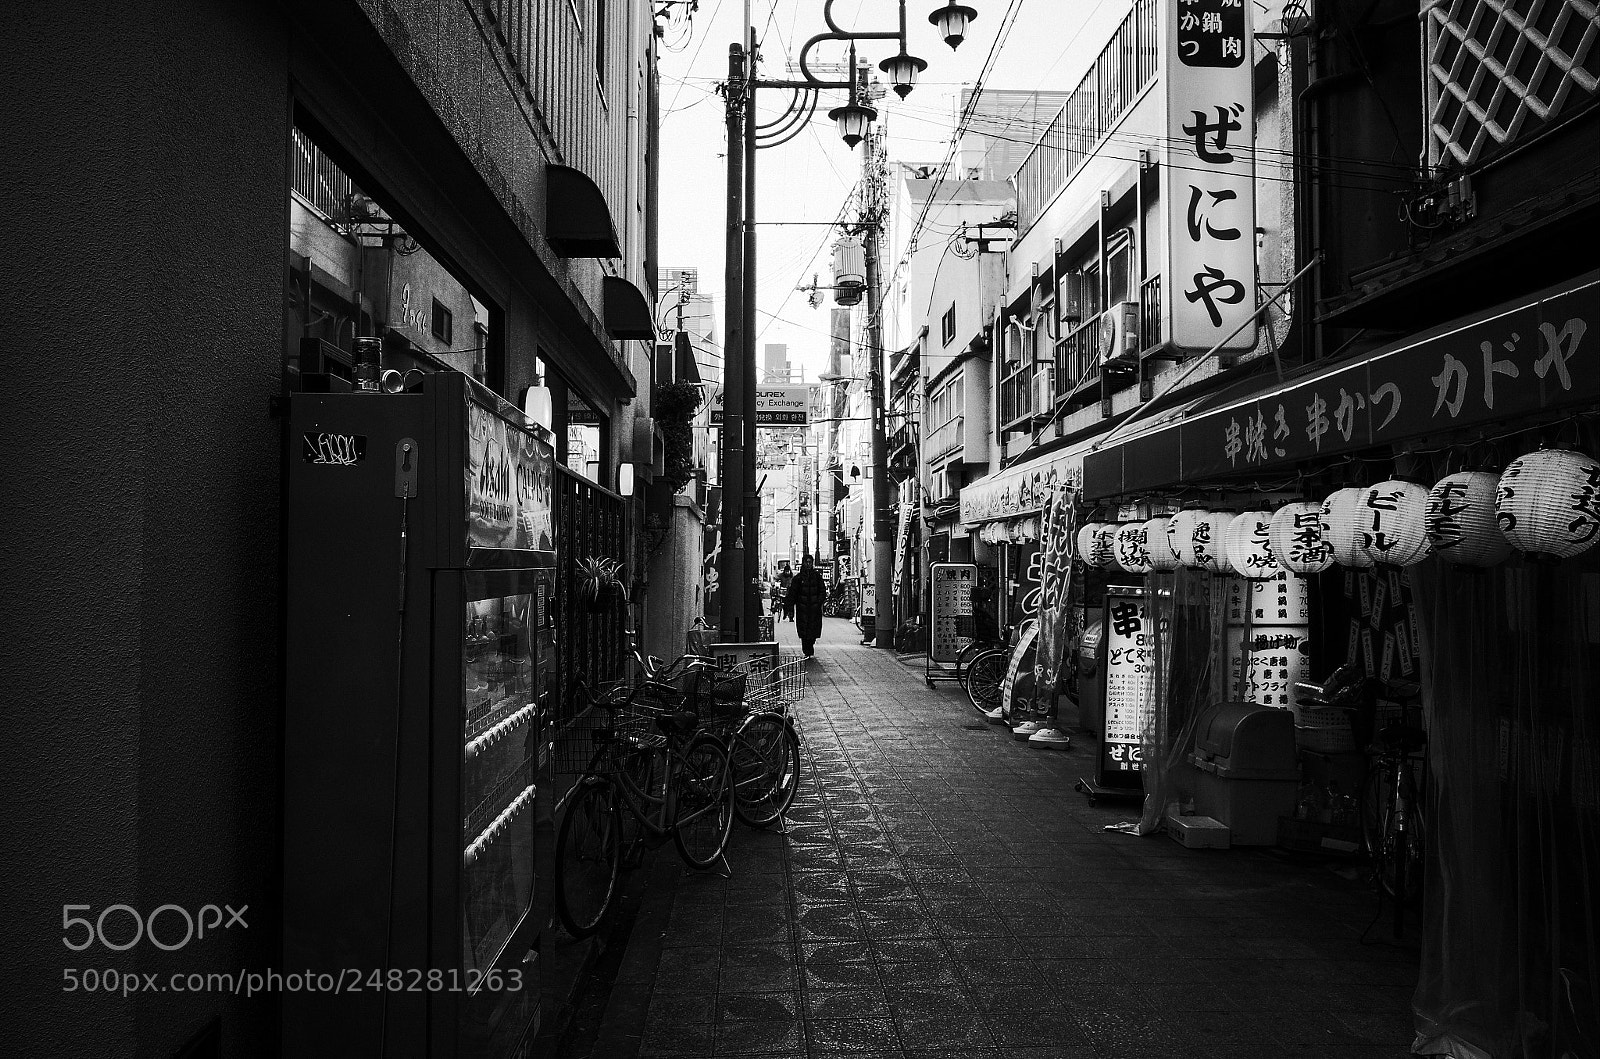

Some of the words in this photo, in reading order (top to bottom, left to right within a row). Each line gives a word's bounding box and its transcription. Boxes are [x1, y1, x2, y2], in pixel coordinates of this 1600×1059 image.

[1182, 102, 1246, 328] ぜにや
[768, 399, 804, 408] Exchange
[1224, 403, 1291, 468] 串焼き
[1305, 381, 1402, 452] 串かつ
[1431, 317, 1588, 418] カドヤ
[480, 439, 509, 501] Asahi
[1290, 513, 1327, 564] 日本酒
[1362, 489, 1405, 551] ビール
